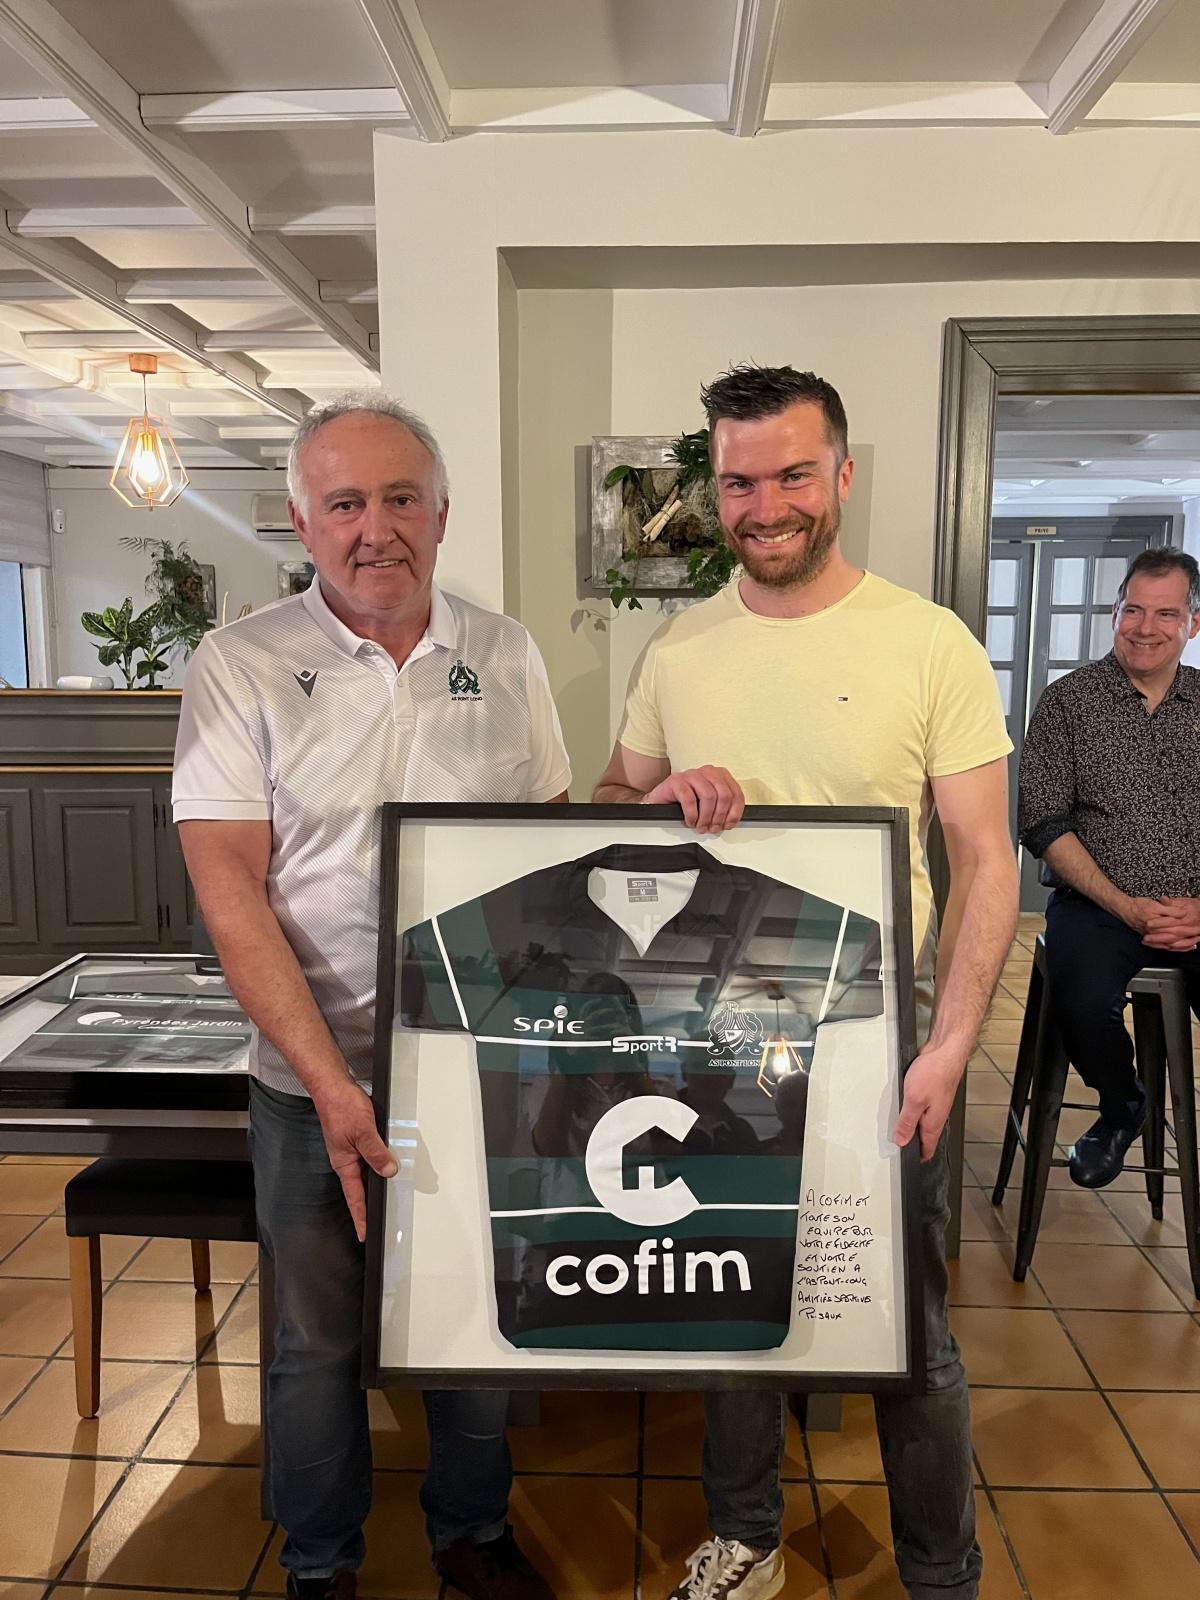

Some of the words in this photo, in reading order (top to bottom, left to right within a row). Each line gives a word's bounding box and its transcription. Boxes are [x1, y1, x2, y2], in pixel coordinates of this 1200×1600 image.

[513, 1004, 585, 1034] SPIE
[855, 1195, 870, 1206] ET
[833, 1213, 856, 1222] SON
[545, 1237, 752, 1296] cofim
